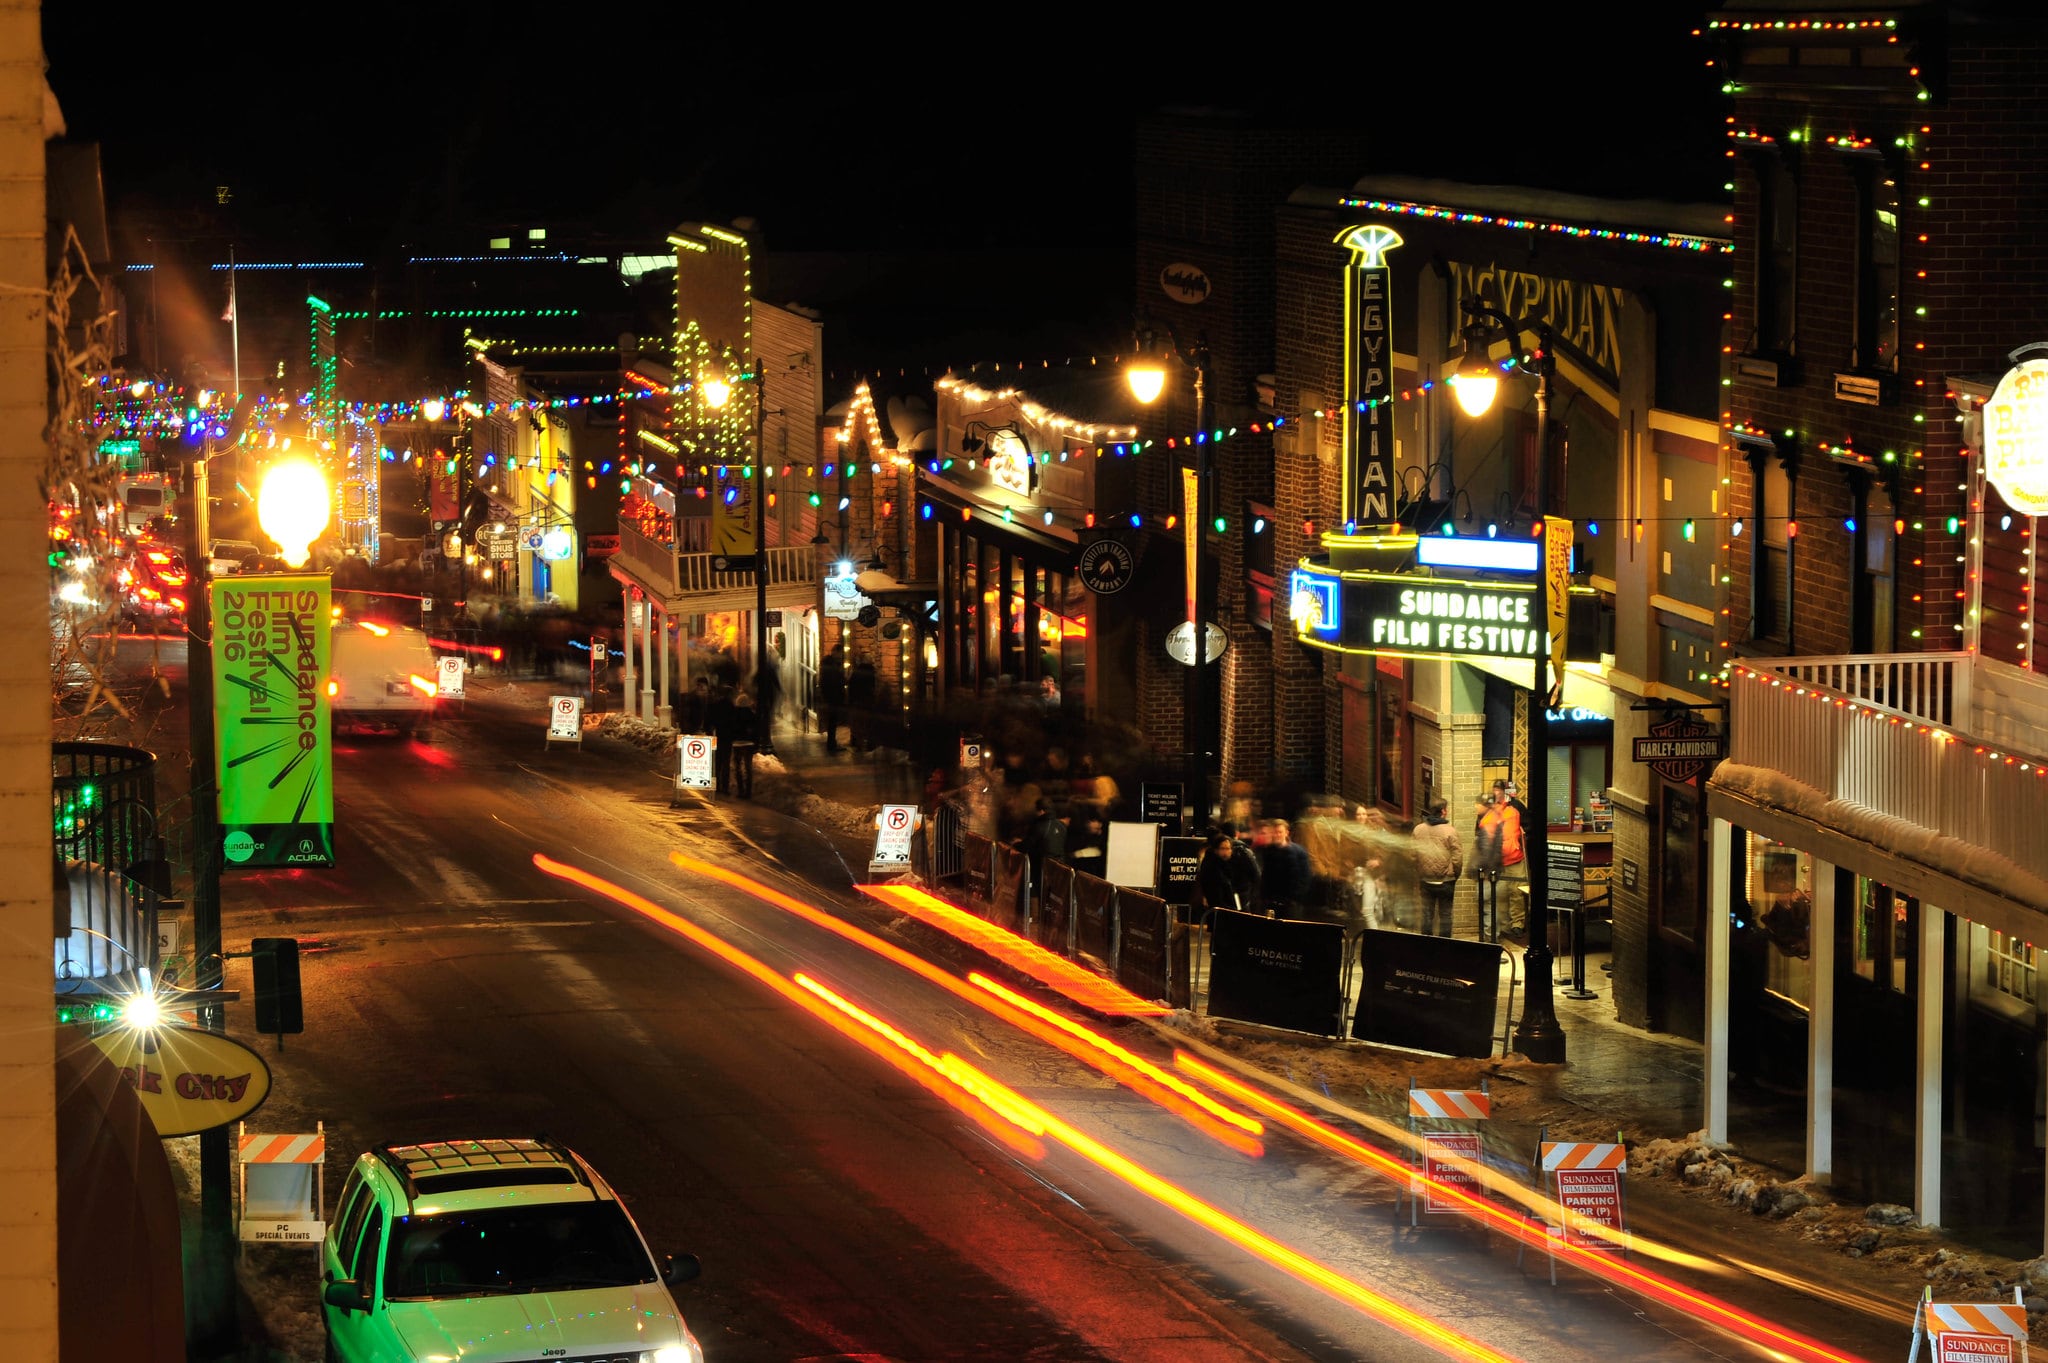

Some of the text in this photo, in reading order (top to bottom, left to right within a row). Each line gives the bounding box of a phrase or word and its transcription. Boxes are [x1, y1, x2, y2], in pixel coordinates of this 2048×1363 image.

[1362, 273, 1388, 519] EGYPTIAN
[1400, 589, 1529, 622] SUNDANCE
[223, 590, 247, 662] 2016
[272, 591, 294, 655] Film
[1373, 618, 1430, 647] FILM
[247, 591, 272, 713] Festival
[296, 590, 320, 751] Sundance
[1640, 741, 1718, 758] HARLEY-DAVIDSON
[1658, 760, 1699, 778] CYCLES
[1247, 947, 1303, 963] SUNDANCE
[1395, 969, 1426, 981] SUNDANCE
[1426, 976, 1440, 984] FILM
[175, 1072, 251, 1103] City
[1429, 1141, 1475, 1149] SUNDANCE
[1433, 1175, 1475, 1183] PARKING
[1563, 1175, 1614, 1184] SUNDANCE
[1564, 1185, 1614, 1193] FILM FESTIVAL
[1566, 1197, 1615, 1205] PARKING
[1596, 1208, 1611, 1216] (P)
[1947, 1340, 2007, 1353] SUNDANCE
[1947, 1353, 2008, 1363] FILM FESTIVAL
